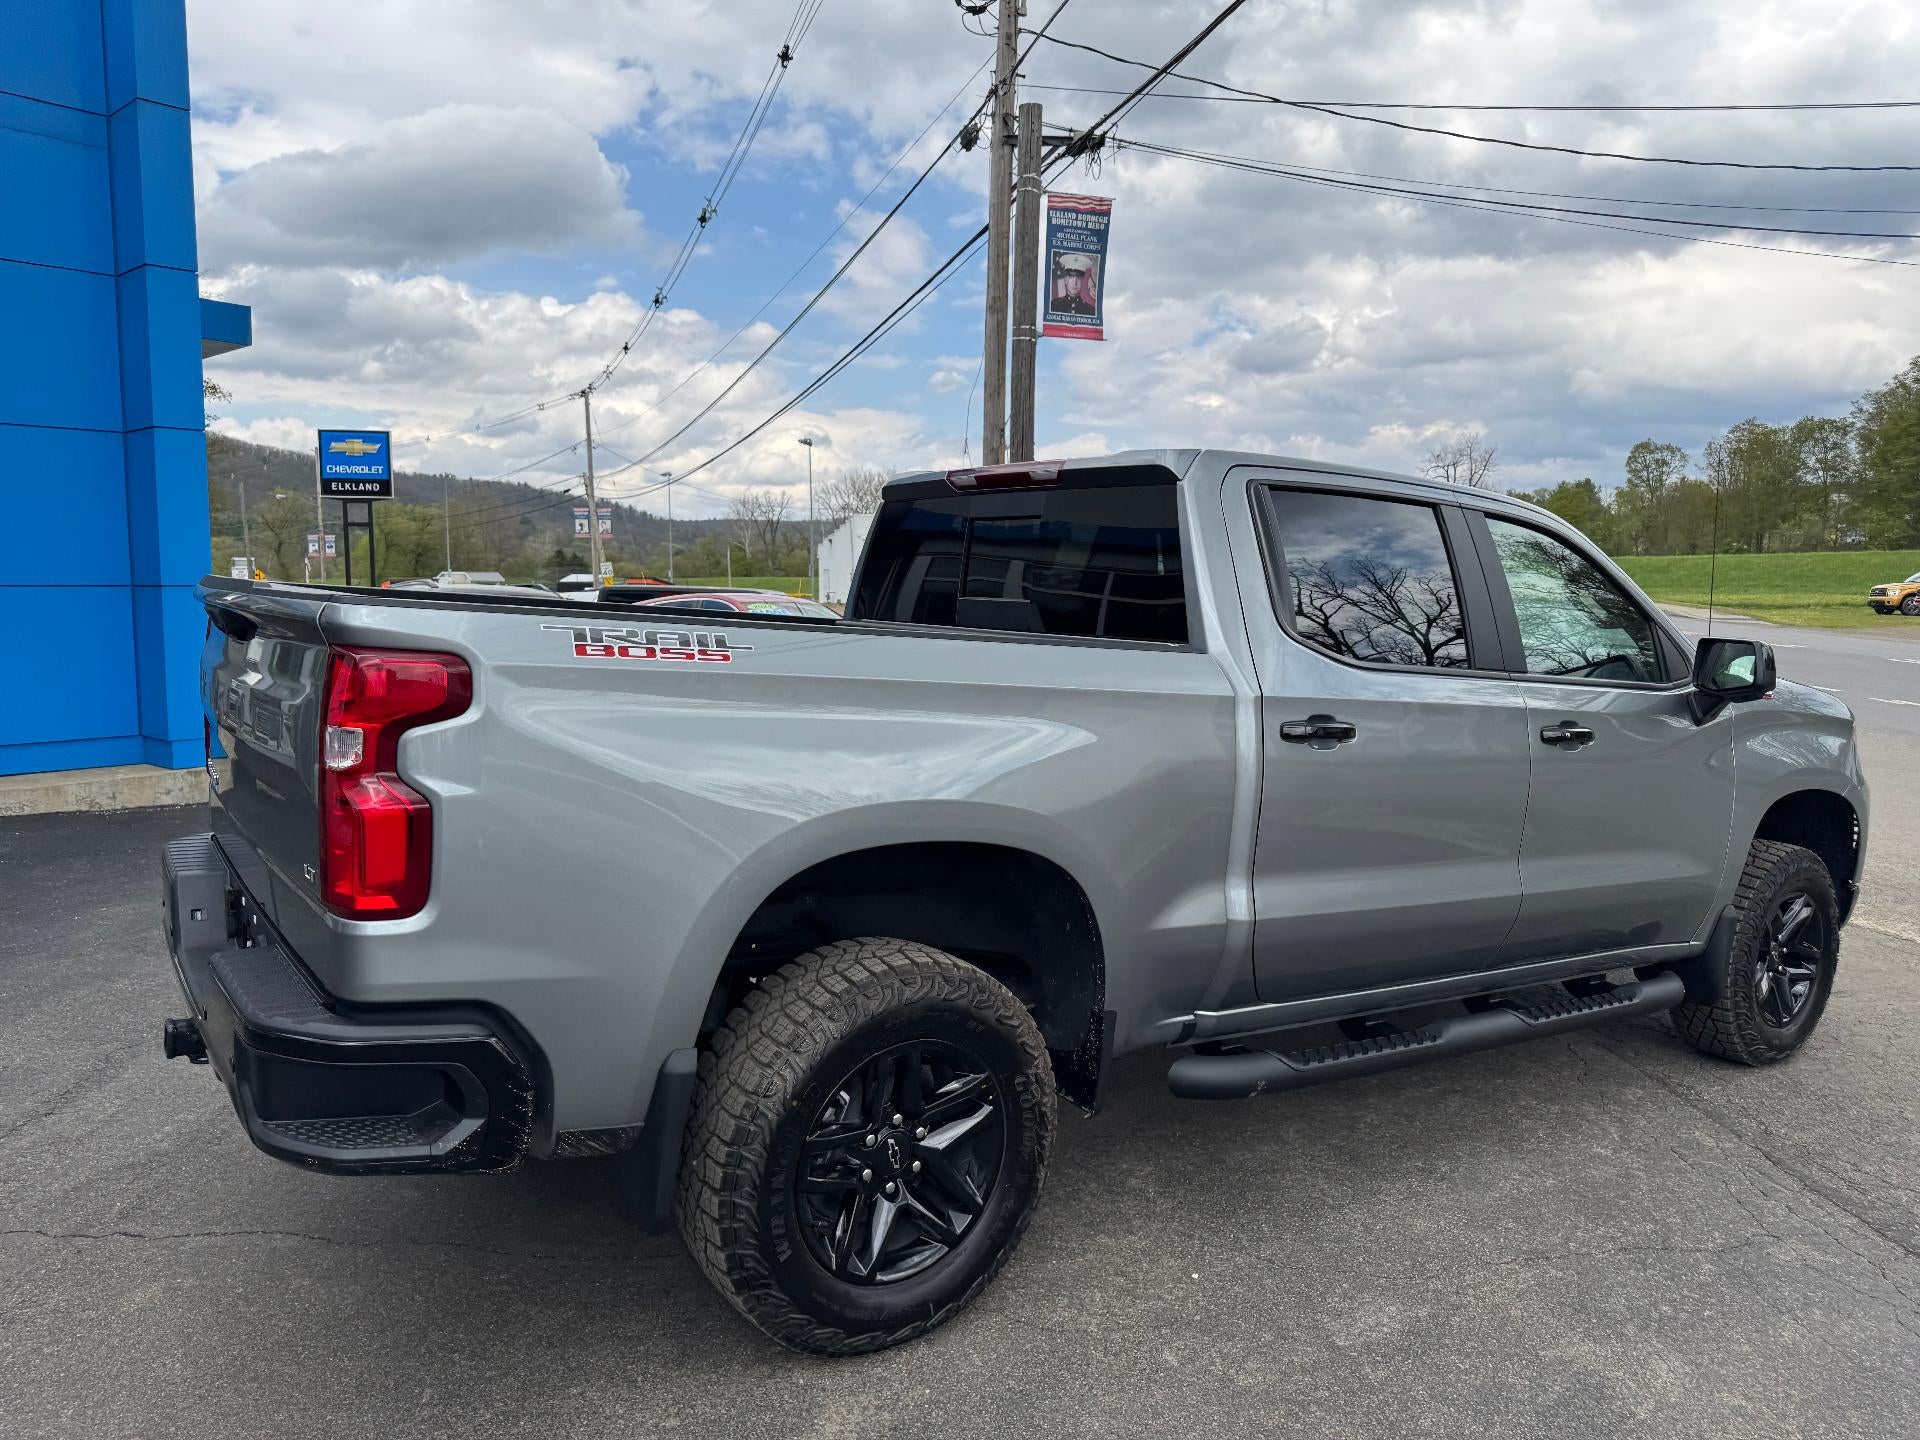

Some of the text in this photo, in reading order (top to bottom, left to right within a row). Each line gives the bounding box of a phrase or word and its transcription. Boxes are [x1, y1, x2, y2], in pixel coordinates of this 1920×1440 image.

[1052, 218, 1105, 230] HOMETOWN HERO
[326, 465, 384, 474] CHEVROLET
[331, 482, 380, 491] ELKLAND
[540, 624, 754, 650] TRAIL
[573, 642, 732, 663] BOSS
